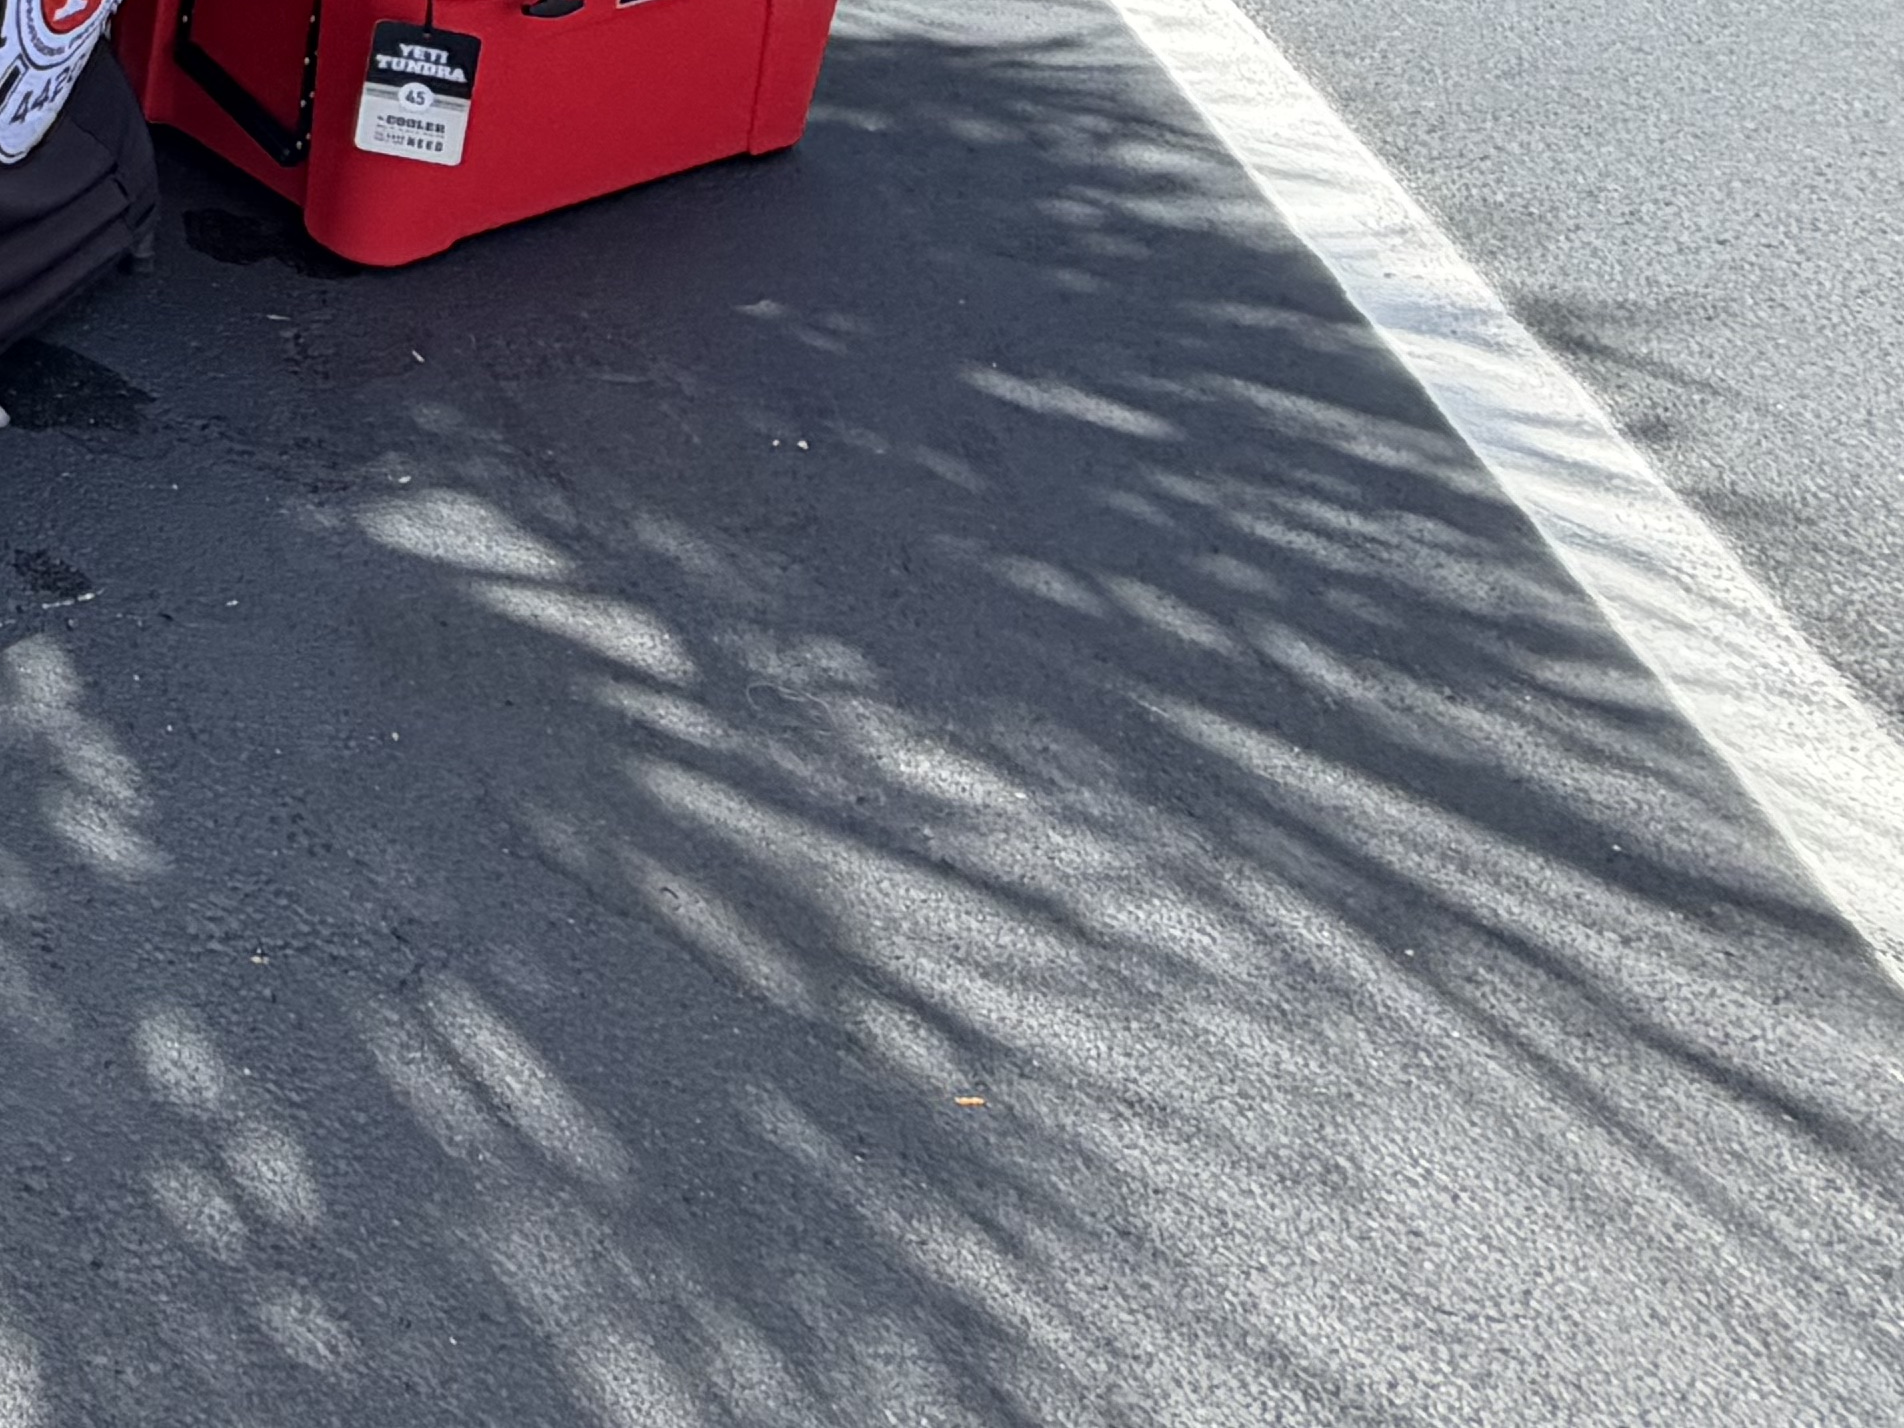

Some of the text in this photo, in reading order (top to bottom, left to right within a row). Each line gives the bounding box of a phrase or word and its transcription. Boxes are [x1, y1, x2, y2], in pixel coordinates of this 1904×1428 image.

[399, 42, 450, 65] YETI
[375, 53, 469, 83] TUNDRA
[404, 89, 426, 106] 45
[385, 114, 446, 134] COOLER
